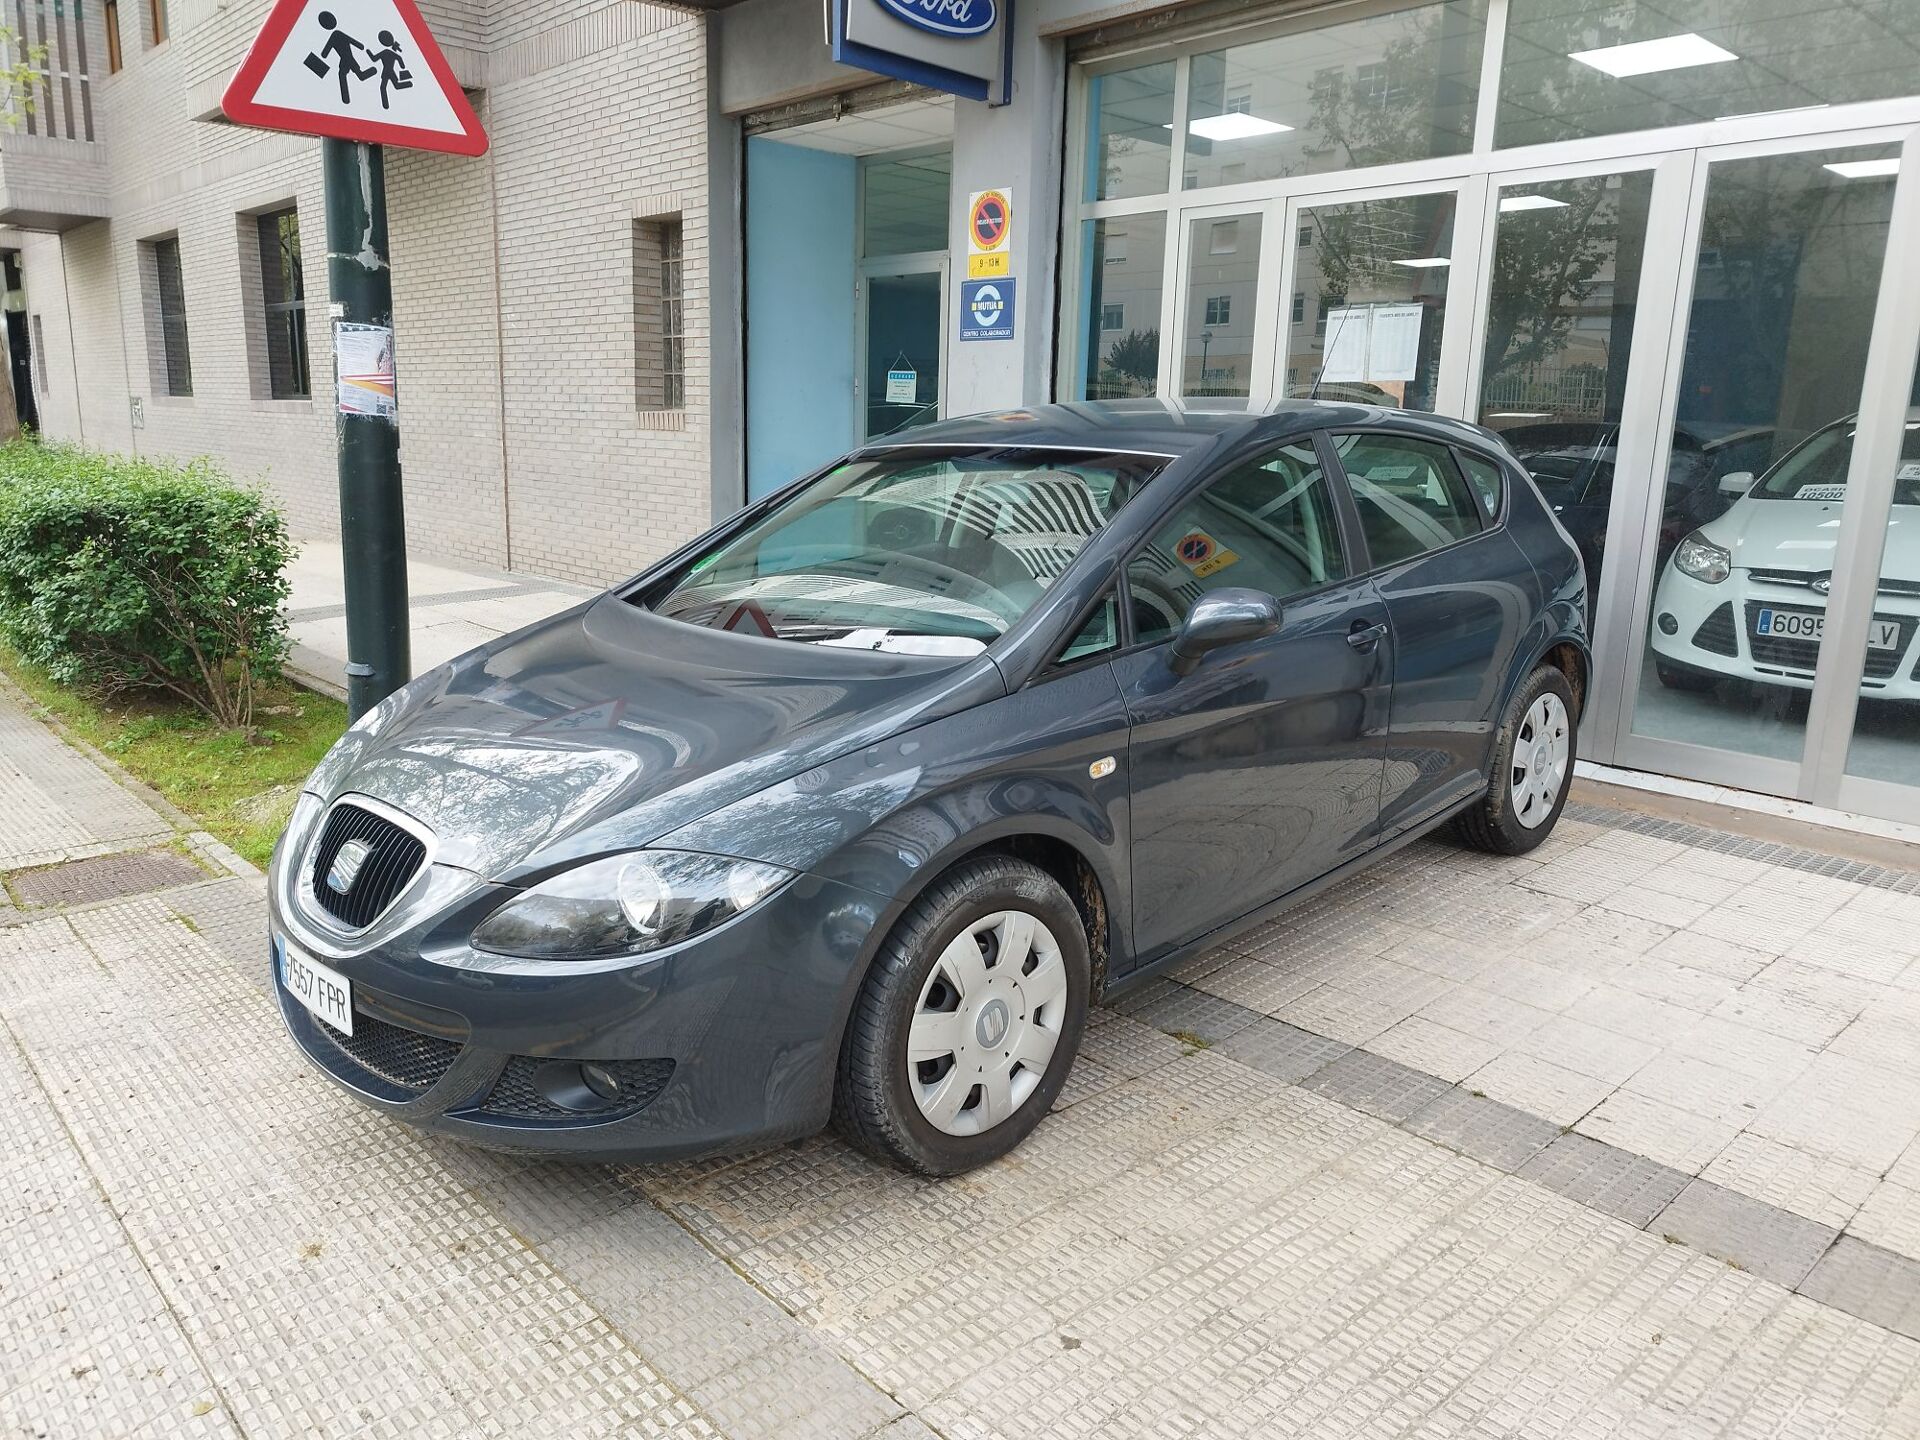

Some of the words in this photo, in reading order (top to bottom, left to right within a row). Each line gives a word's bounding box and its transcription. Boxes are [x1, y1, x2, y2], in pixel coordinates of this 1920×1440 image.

[902, 0, 972, 23] ord
[1800, 491, 1843, 499] 10500
[286, 952, 314, 999] 7557
[317, 976, 347, 1022] FPR
